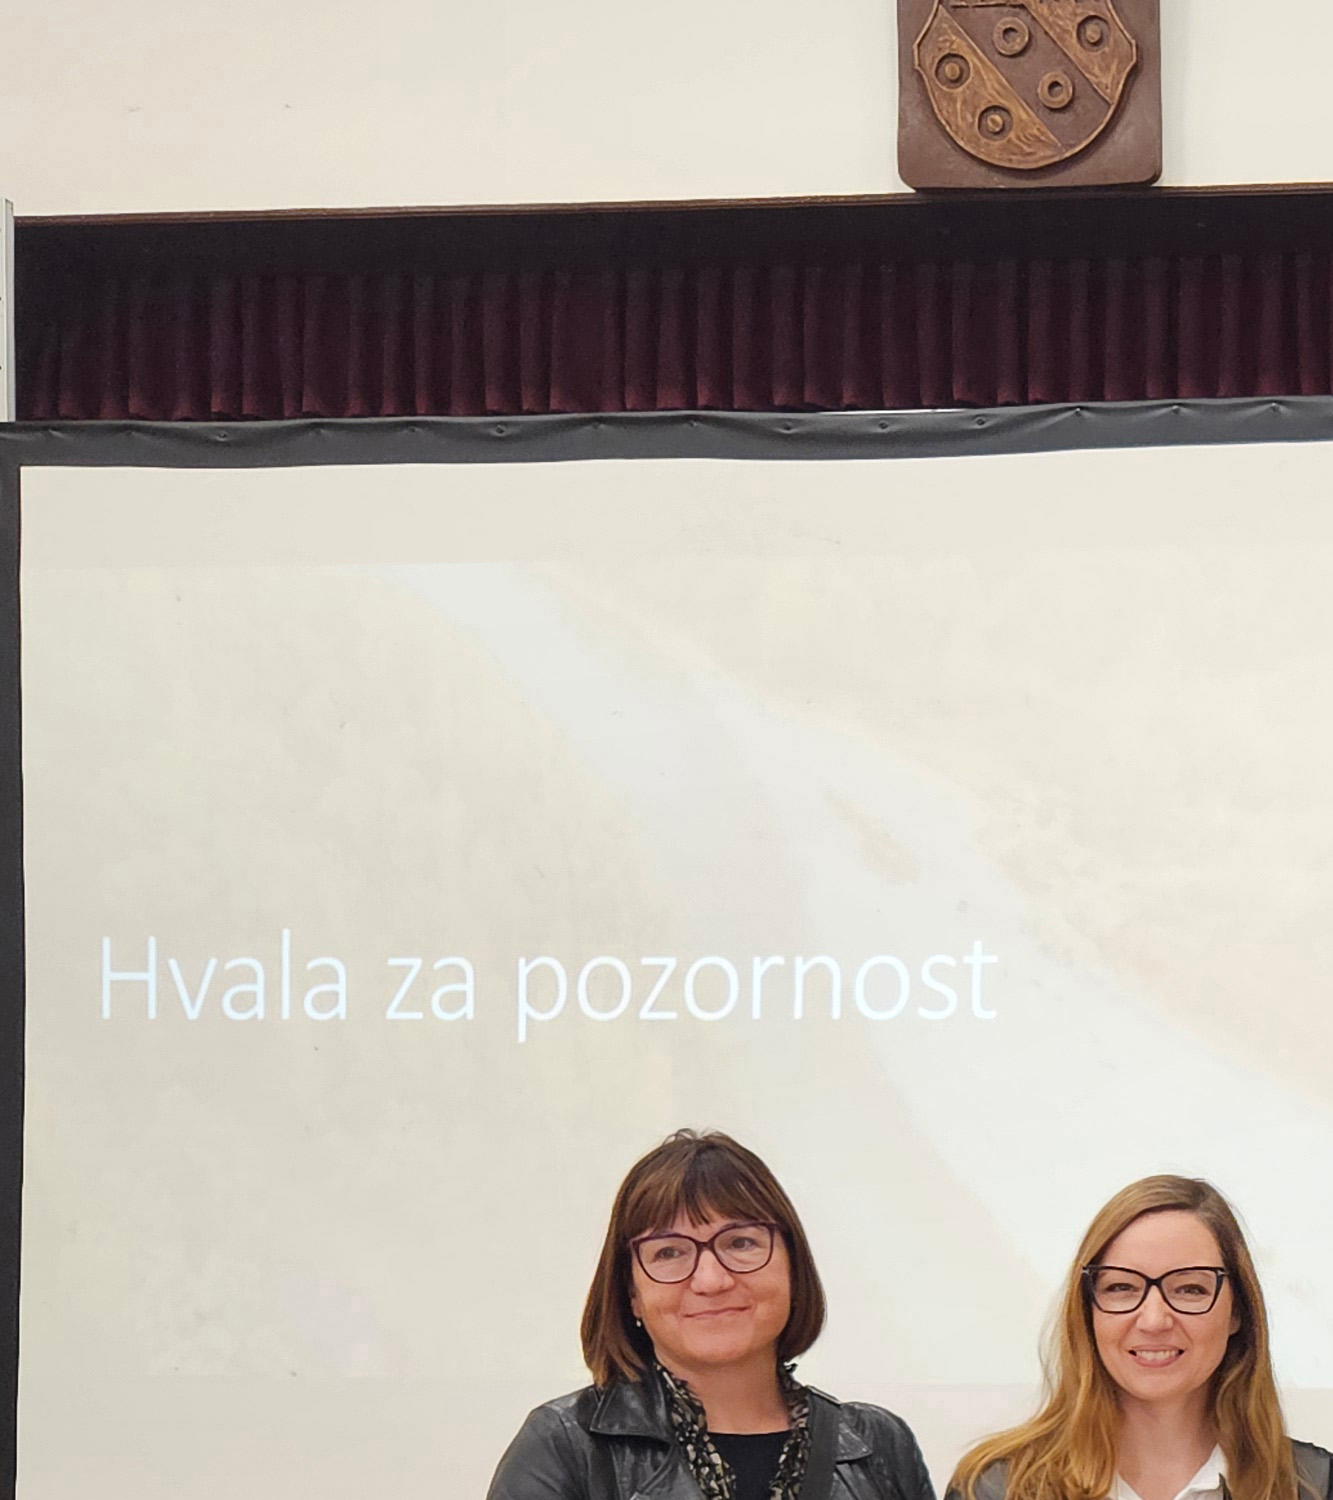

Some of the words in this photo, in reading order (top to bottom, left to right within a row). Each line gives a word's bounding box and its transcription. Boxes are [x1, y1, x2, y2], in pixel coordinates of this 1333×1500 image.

[100, 929, 349, 1022] Hvala
[384, 955, 476, 1022] za
[517, 939, 999, 1043] pozornost
